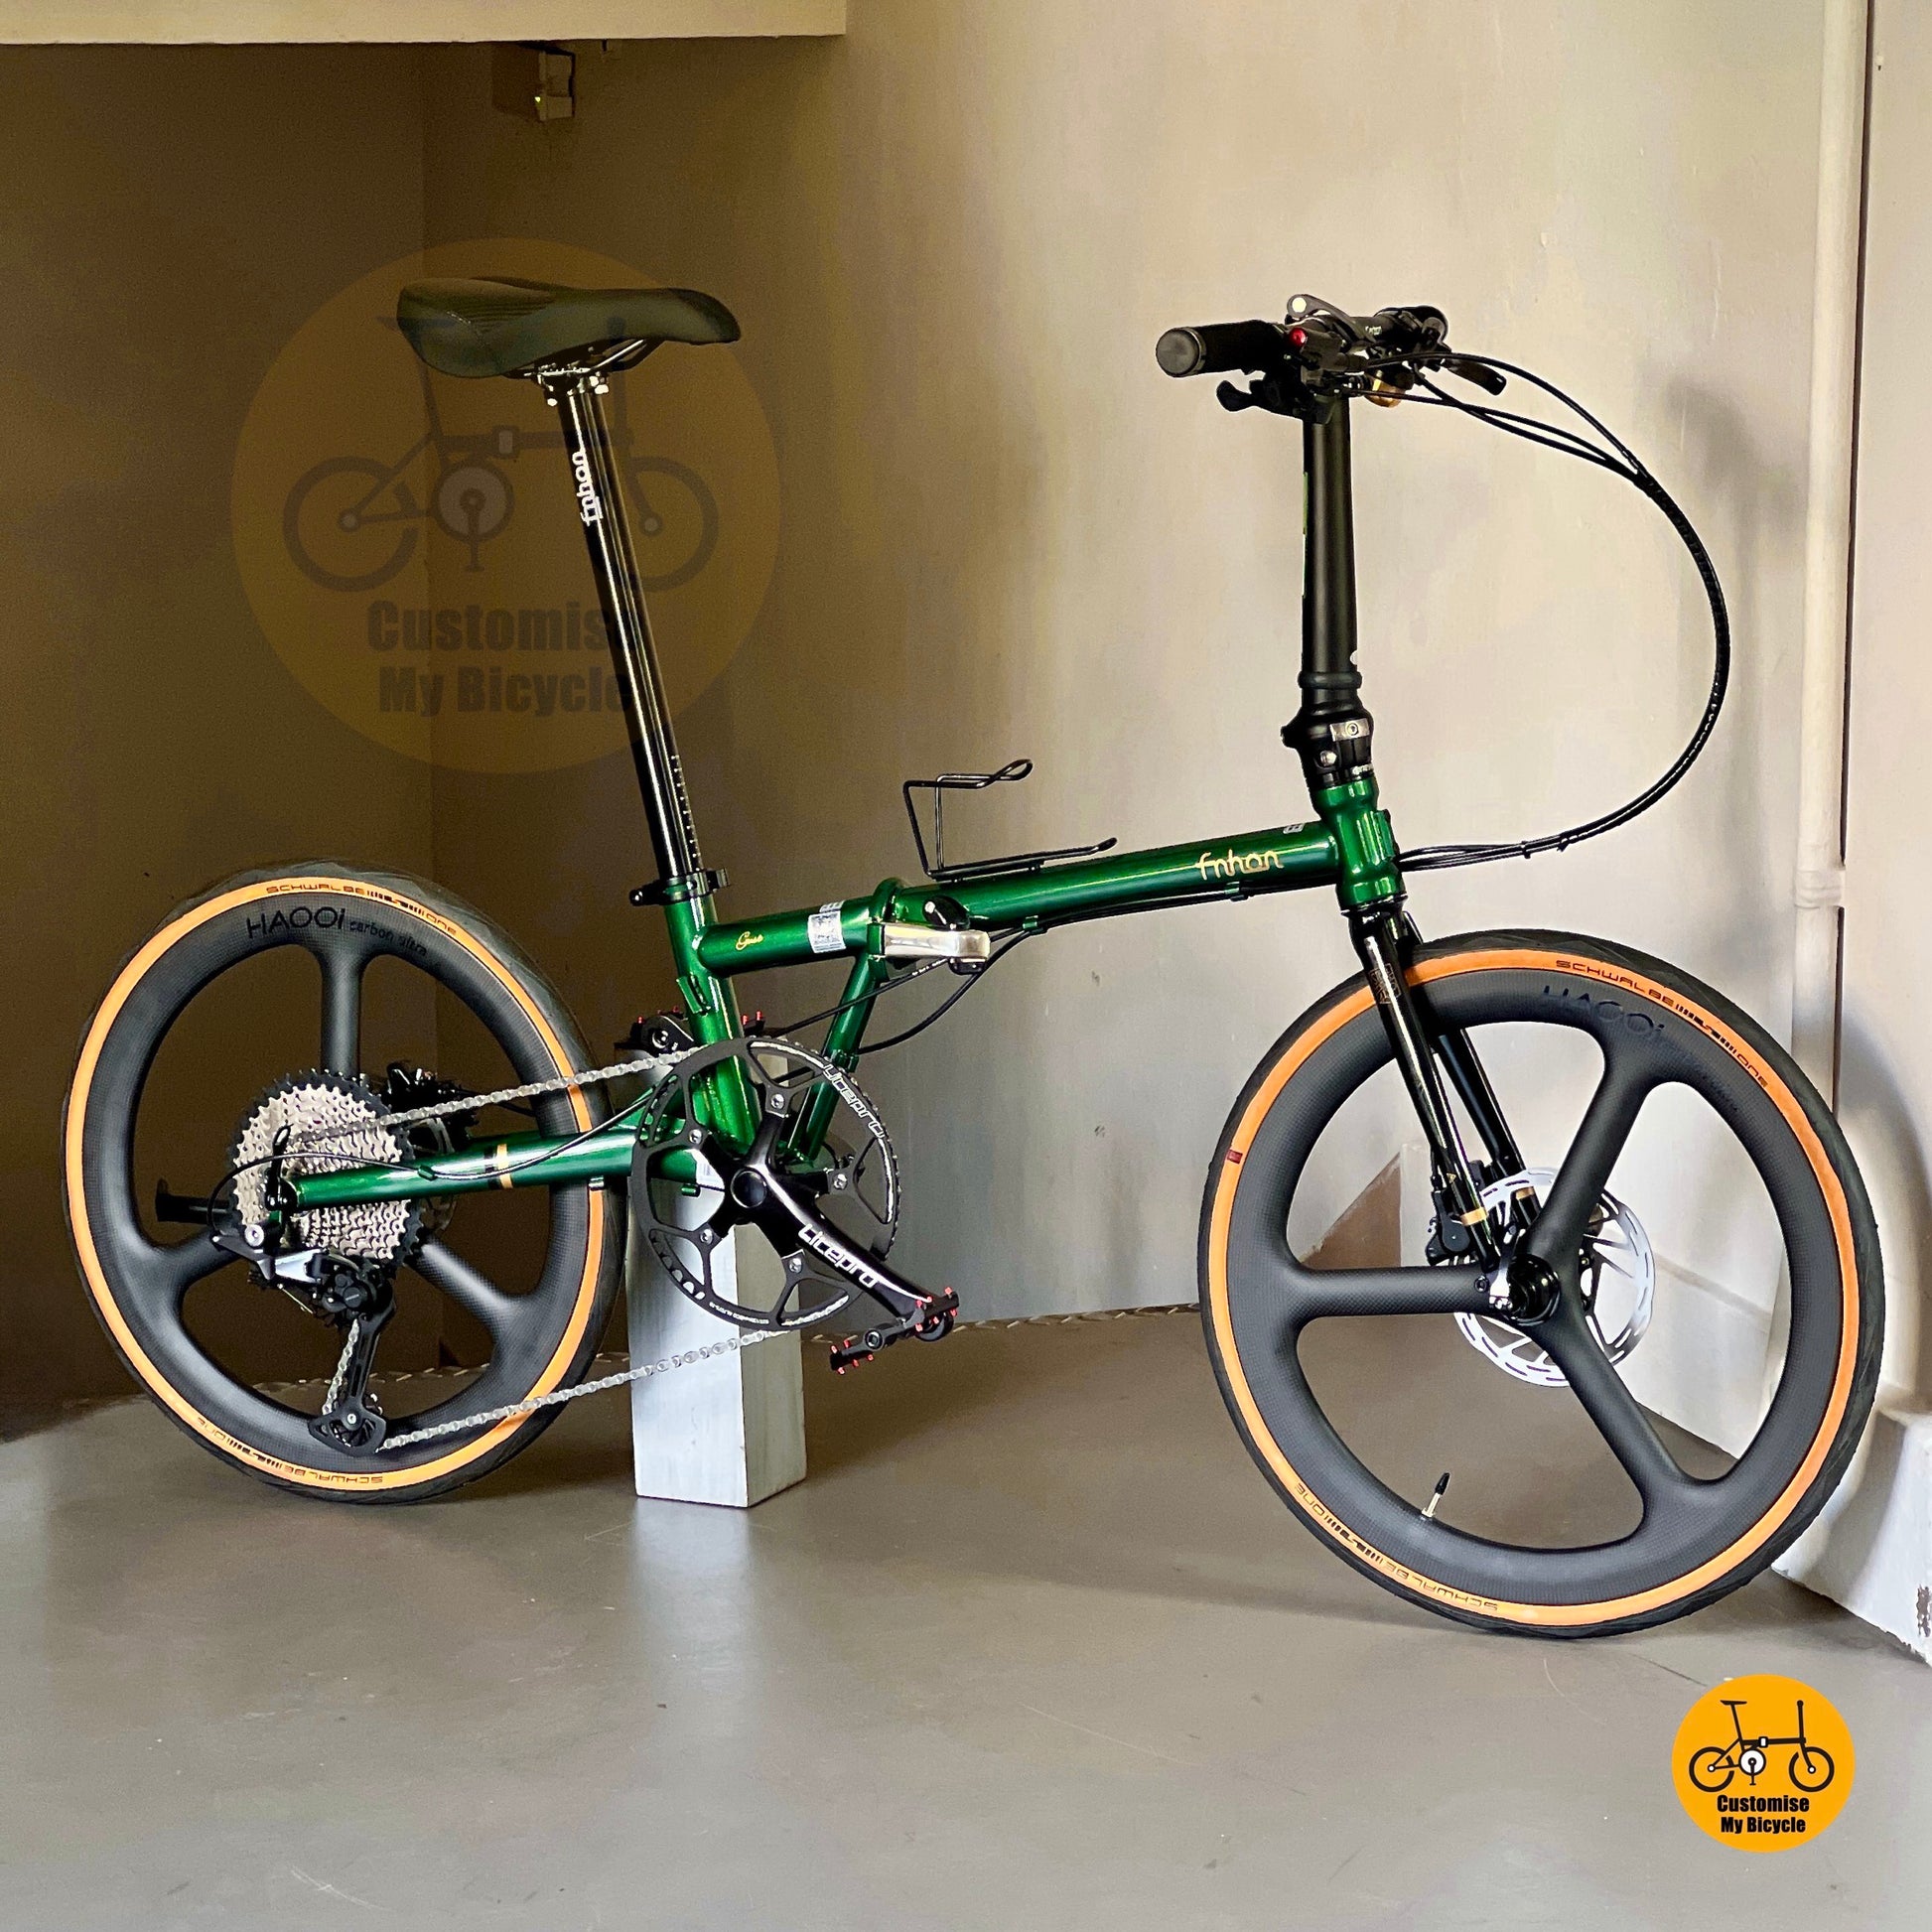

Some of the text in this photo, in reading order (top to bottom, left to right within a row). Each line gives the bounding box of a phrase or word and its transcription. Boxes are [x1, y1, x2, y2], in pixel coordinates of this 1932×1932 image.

[265, 883, 365, 895] SCHWALBE
[1555, 959, 1676, 1008] SCHWALBE
[284, 1464, 384, 1485] SCHWALBE
[1385, 1562, 1499, 1612] SCHWALBE
